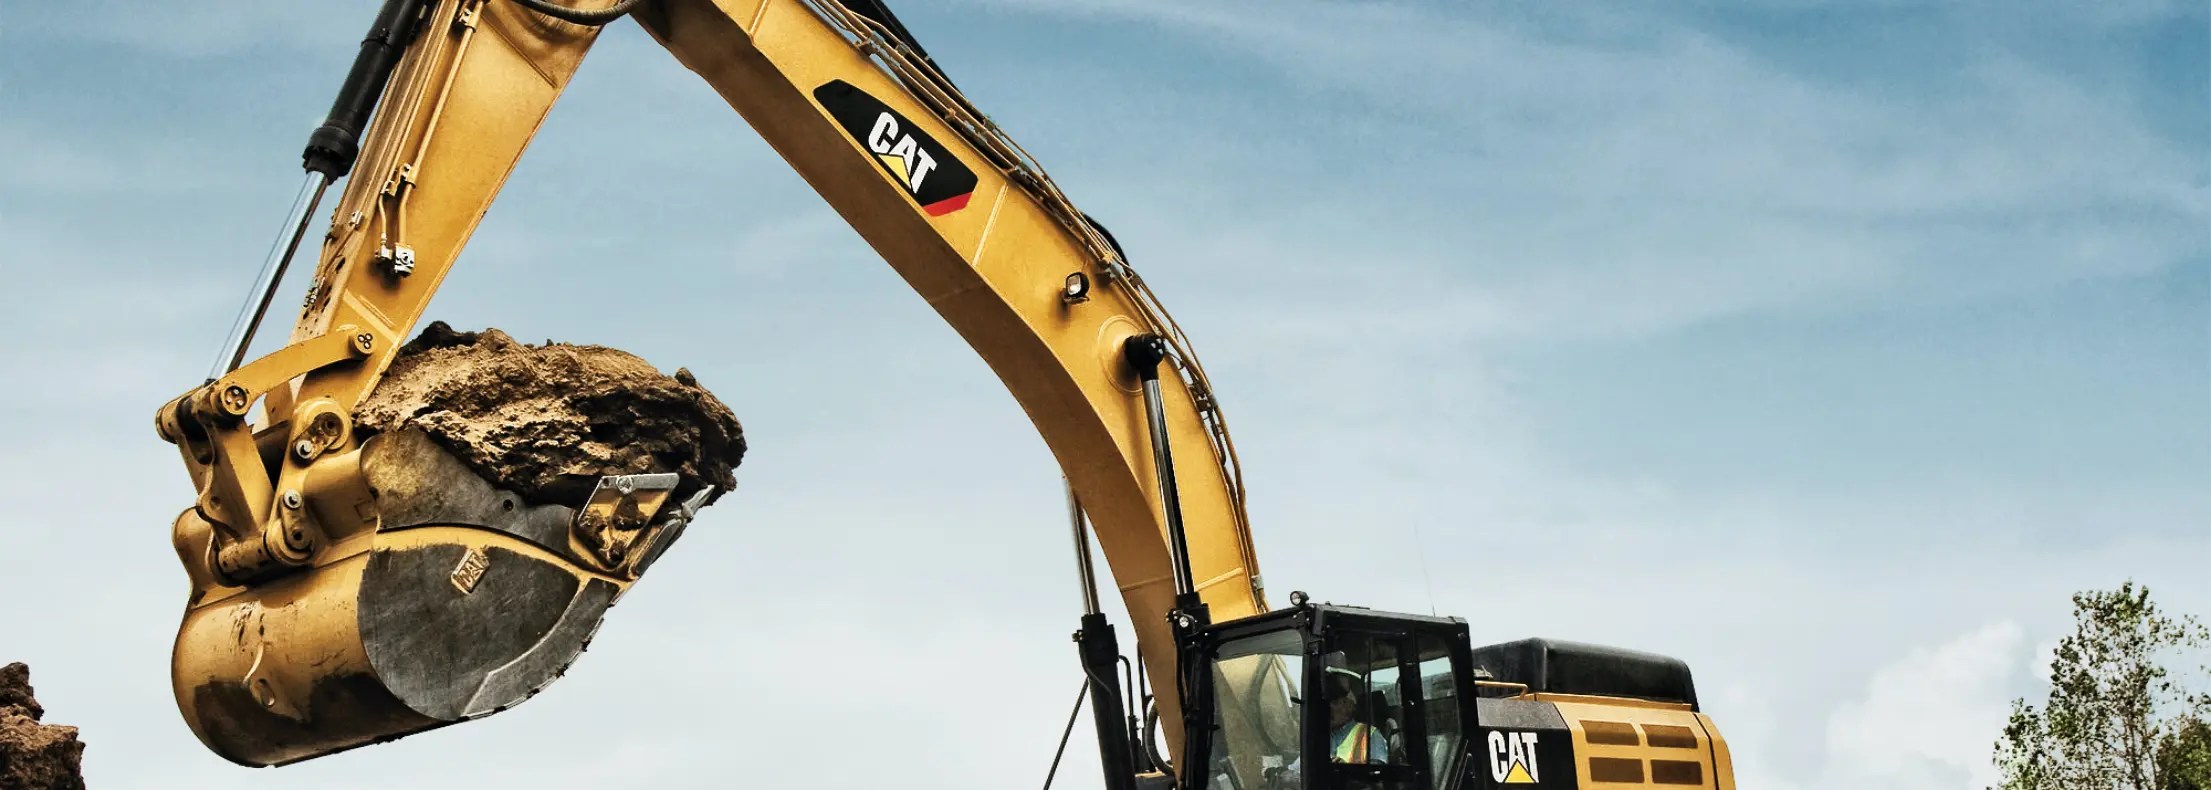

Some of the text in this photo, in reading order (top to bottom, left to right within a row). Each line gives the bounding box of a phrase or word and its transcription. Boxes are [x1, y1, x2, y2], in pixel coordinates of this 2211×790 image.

[868, 111, 938, 194] CAT
[457, 553, 484, 588] CAT
[1487, 730, 1540, 783] CAT
